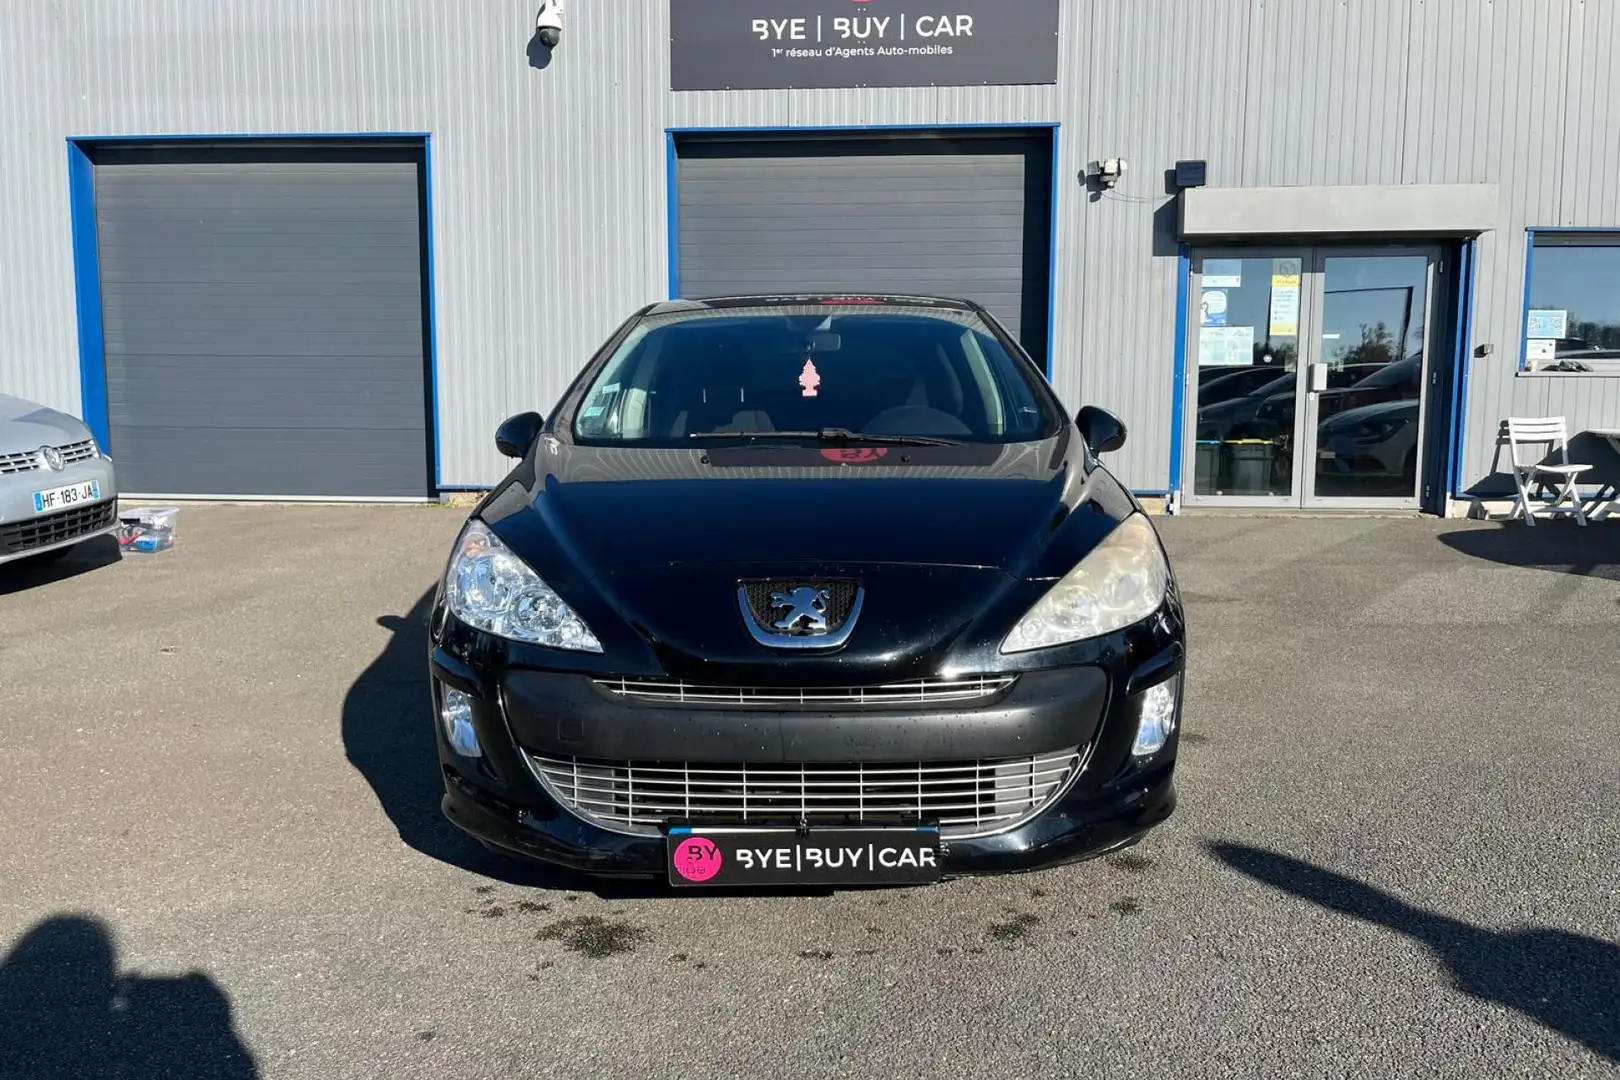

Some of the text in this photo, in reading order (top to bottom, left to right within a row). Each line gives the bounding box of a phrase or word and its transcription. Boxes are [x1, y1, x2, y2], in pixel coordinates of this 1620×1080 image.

[752, 14, 973, 40] BYE BUY CAR
[785, 47, 822, 58] réseau
[824, 46, 875, 59] d'Agents
[876, 44, 954, 56] Auto-mobiles
